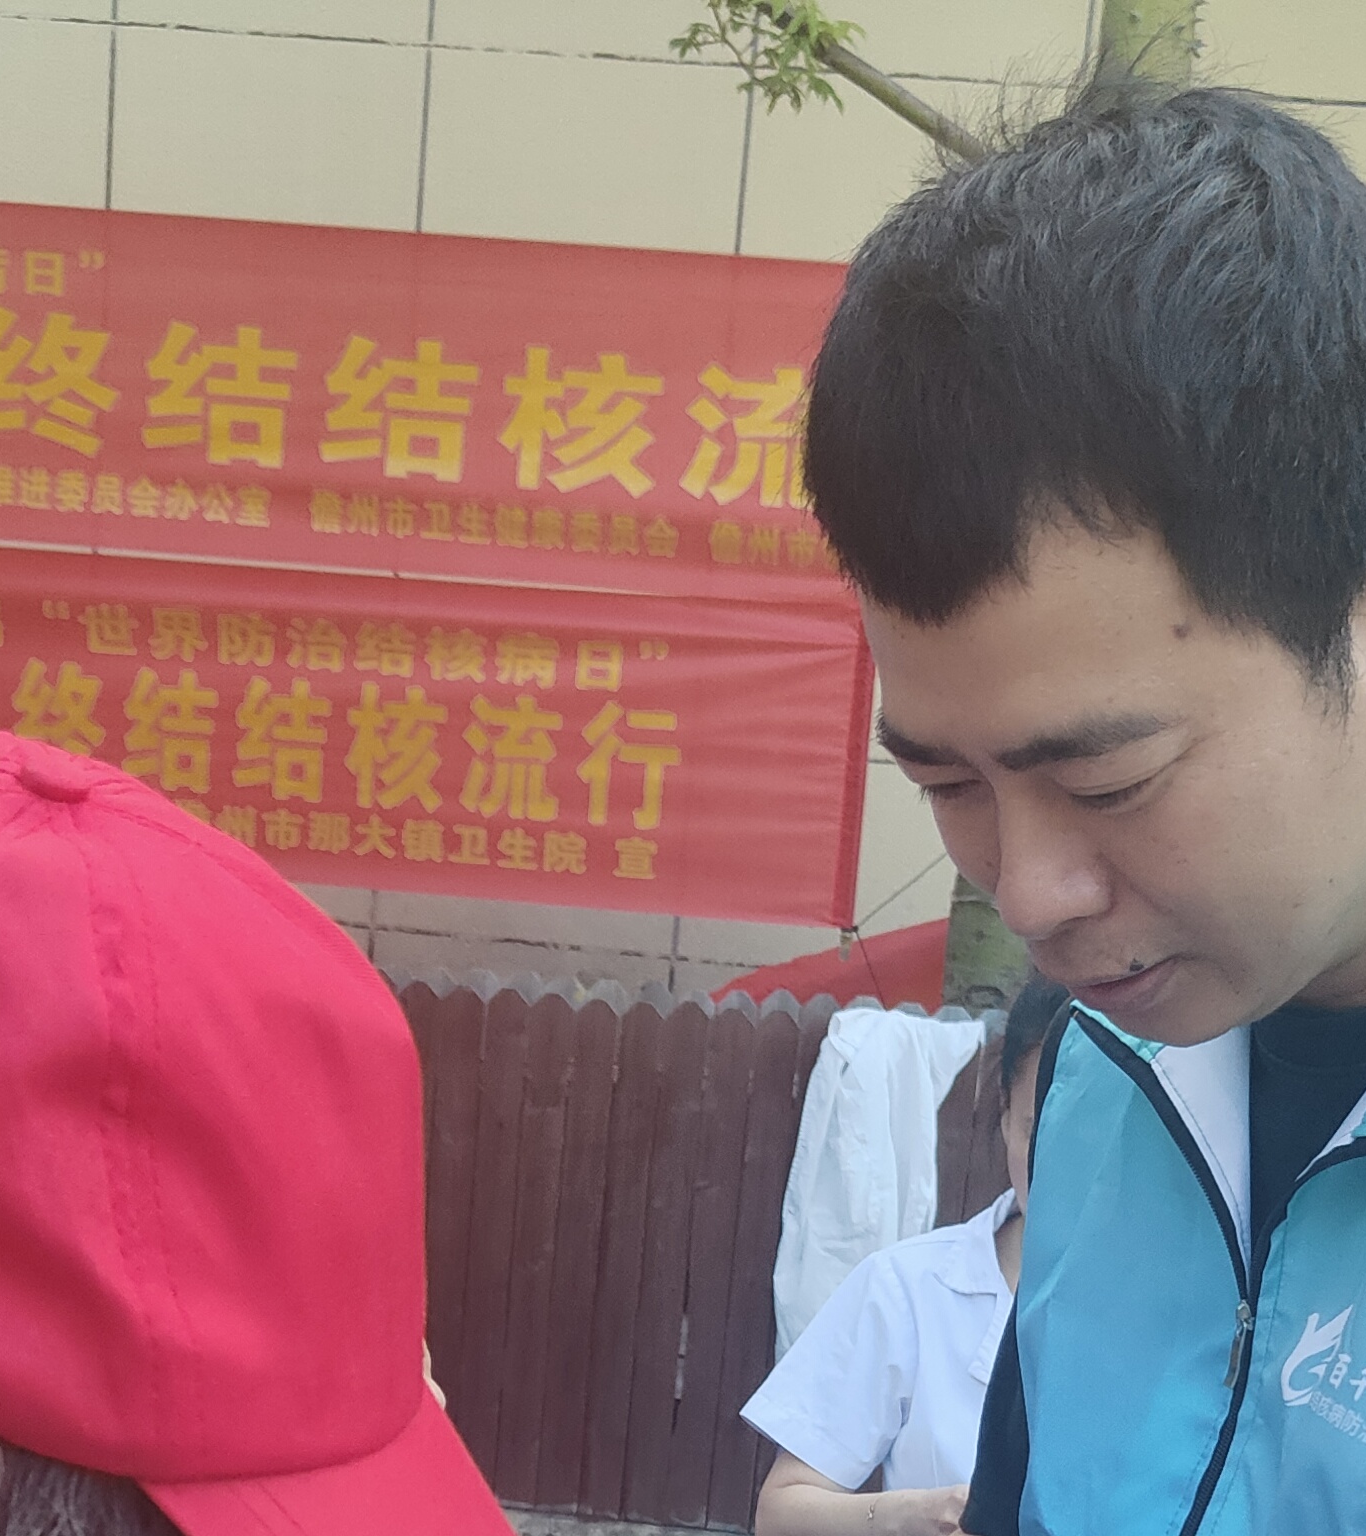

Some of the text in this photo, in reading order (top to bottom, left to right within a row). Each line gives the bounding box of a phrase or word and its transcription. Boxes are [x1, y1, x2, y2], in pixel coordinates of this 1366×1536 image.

[12, 657, 682, 831] 终结结核流行
